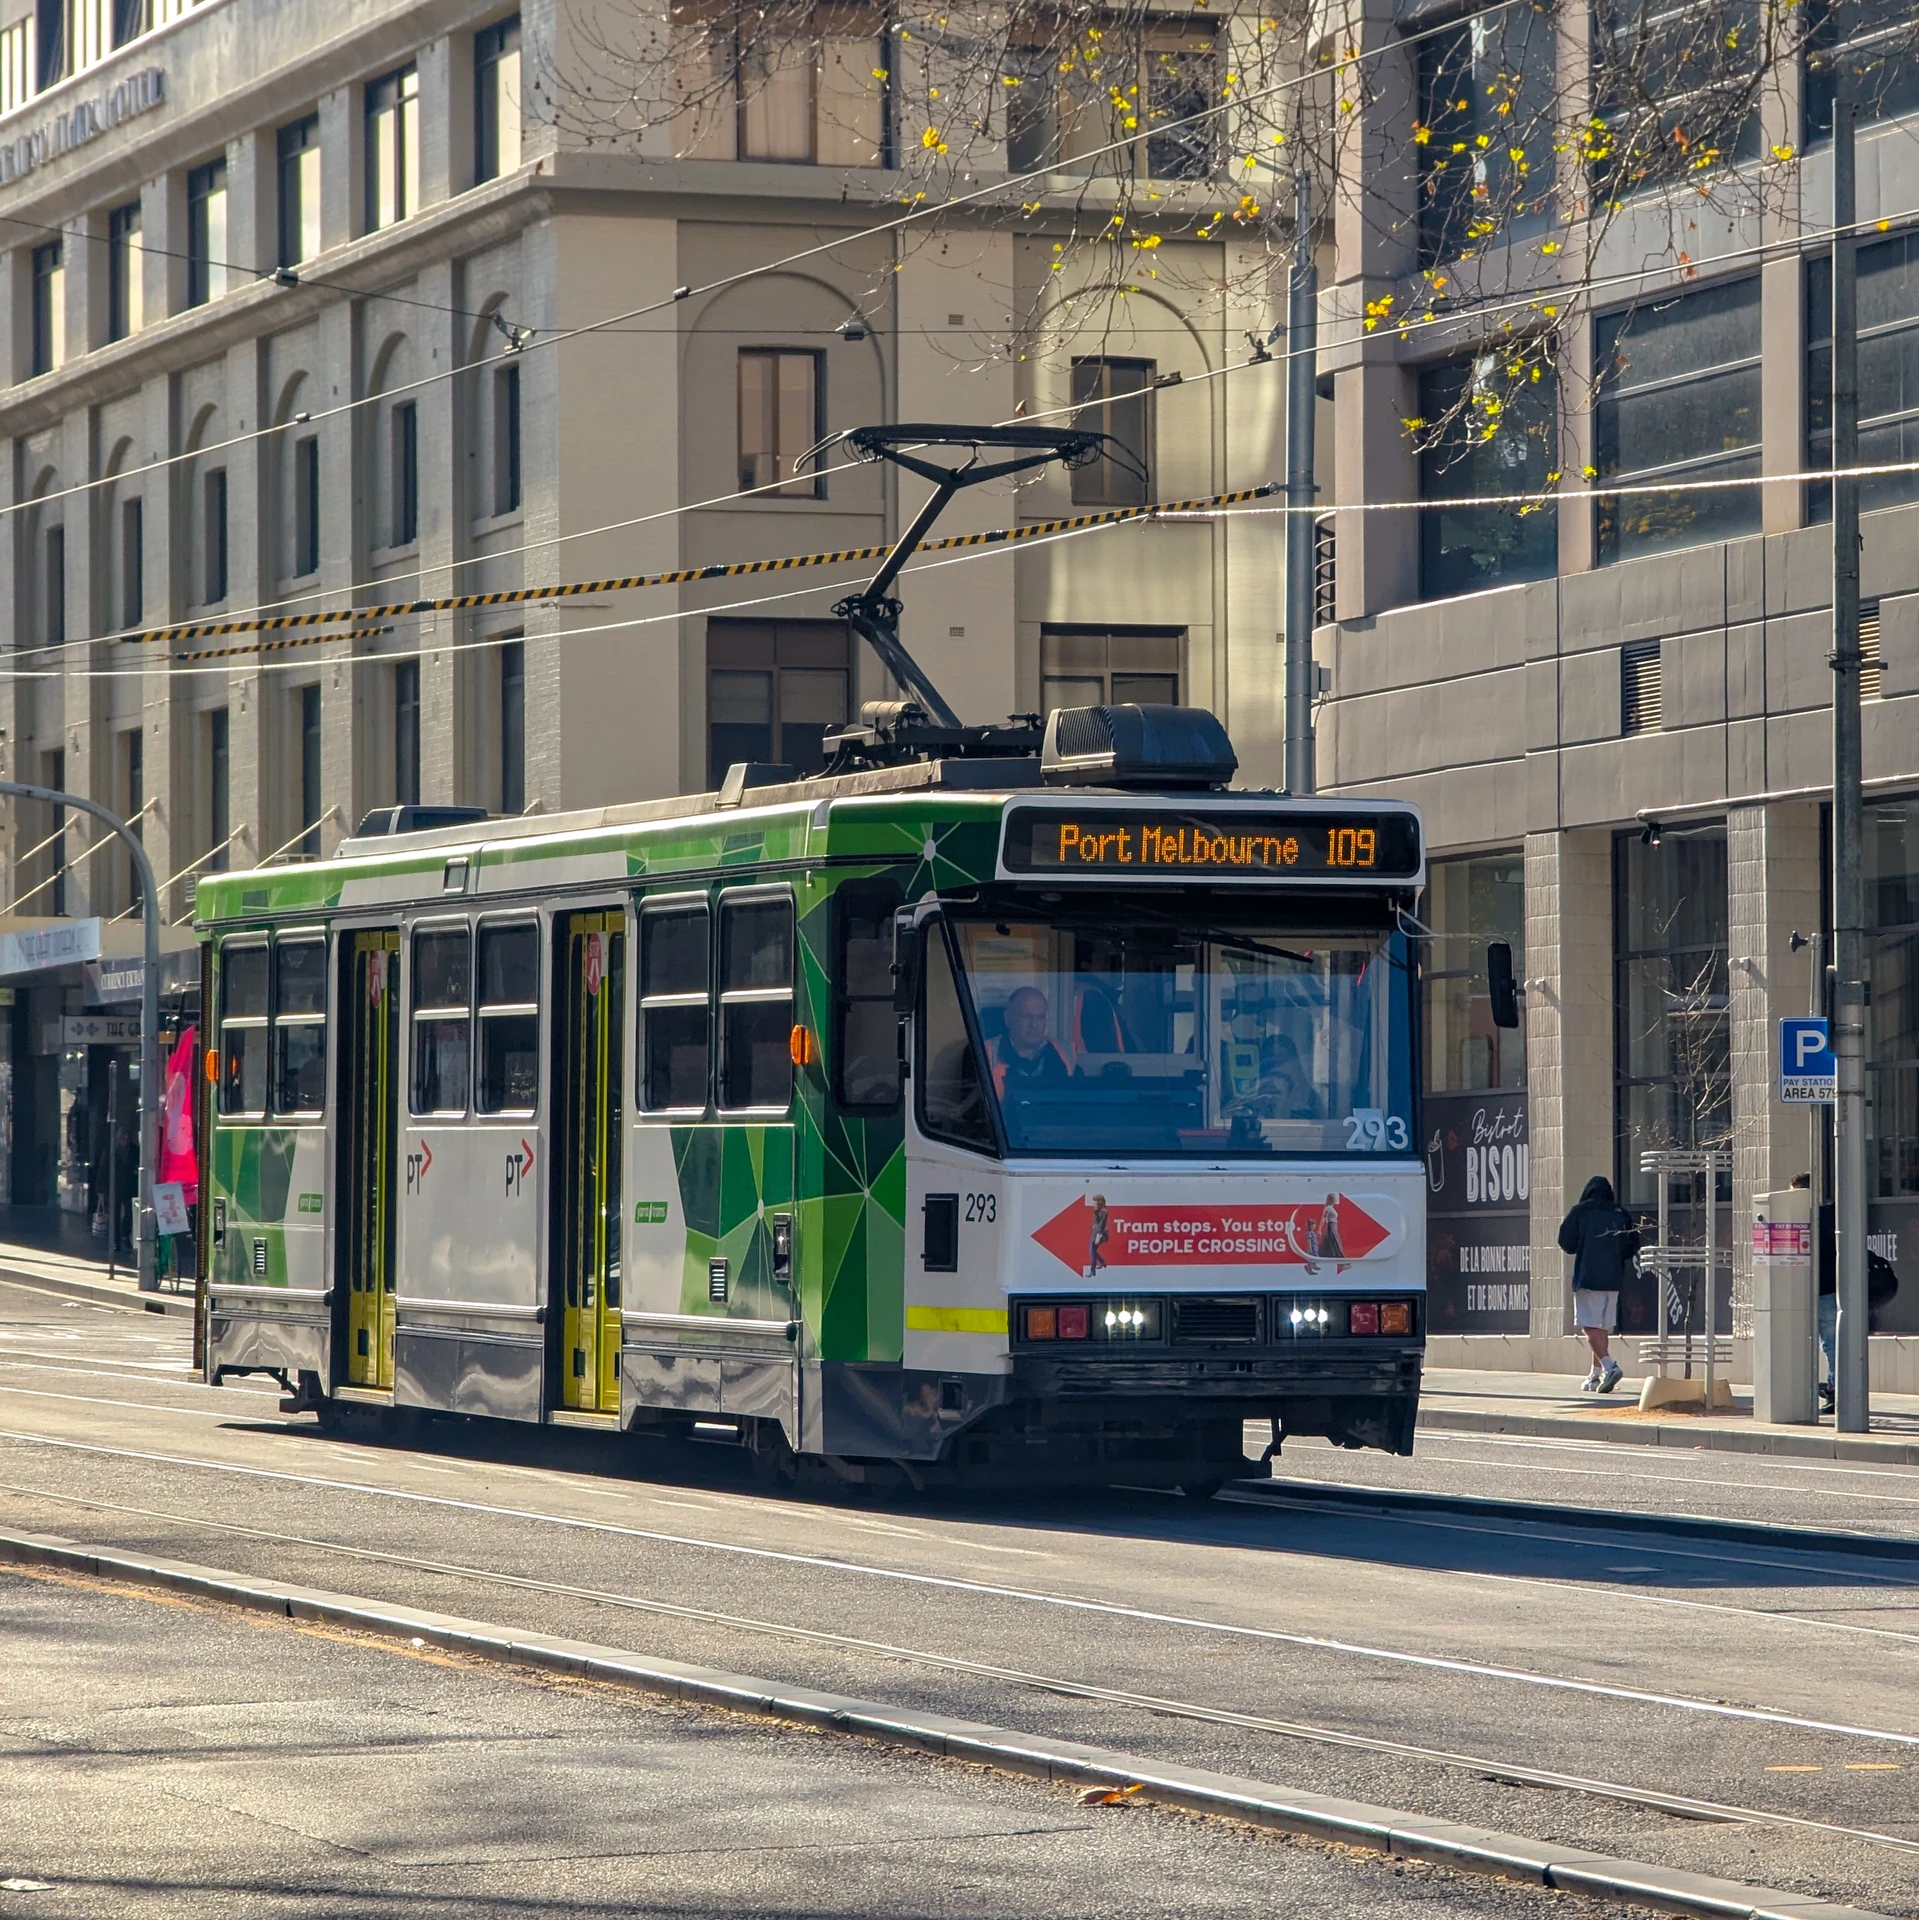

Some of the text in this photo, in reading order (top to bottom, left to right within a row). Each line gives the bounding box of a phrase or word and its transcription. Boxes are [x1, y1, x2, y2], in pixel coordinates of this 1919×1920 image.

[1058, 824, 1376, 867] Port Melbourne 109
[1796, 1029, 1826, 1067] P
[1783, 1088, 1815, 1099] AREA
[1342, 1115, 1409, 1149] 293
[1471, 1106, 1523, 1144] Bistrot
[1466, 1144, 1529, 1202] BISOU
[965, 1192, 996, 1223] 293
[1113, 1219, 1158, 1233] Tram
[1163, 1219, 1216, 1236] stops.
[1221, 1218, 1252, 1232] You
[1128, 1238, 1286, 1254] PEOPLE CROSSING
[1460, 1245, 1531, 1272] DE LA BONNE BOUFF
[1467, 1284, 1528, 1310] ET DE BONS AMIS
